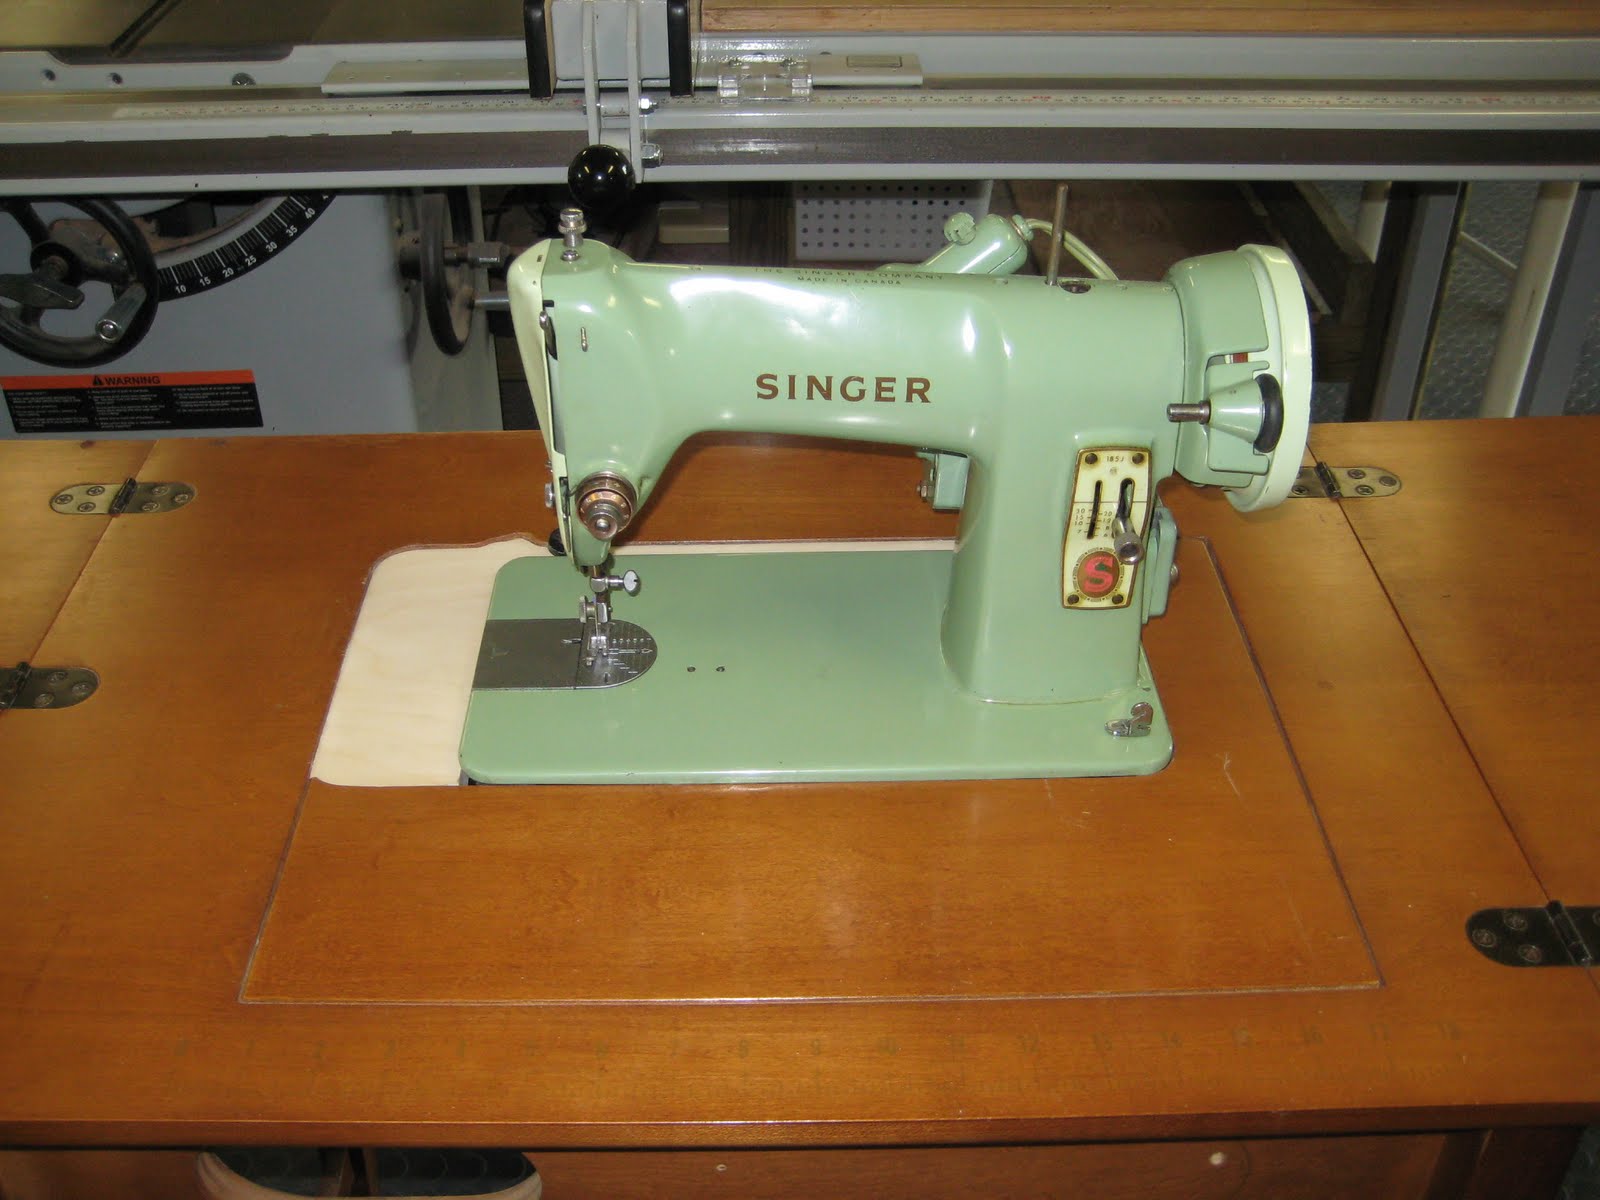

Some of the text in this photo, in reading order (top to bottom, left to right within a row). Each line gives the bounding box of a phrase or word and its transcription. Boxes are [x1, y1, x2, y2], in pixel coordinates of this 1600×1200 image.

[304, 207, 316, 219] 40
[286, 225, 298, 237] 35
[266, 241, 278, 253] 30
[245, 255, 257, 266] 25
[222, 267, 234, 277] 20
[794, 269, 856, 277] SINGER
[866, 271, 944, 280] COMPANY
[199, 276, 211, 287] 15
[175, 284, 187, 294] 10
[106, 375, 161, 386] WARNING
[756, 373, 931, 403] SINGER
[1084, 556, 1114, 593] S
